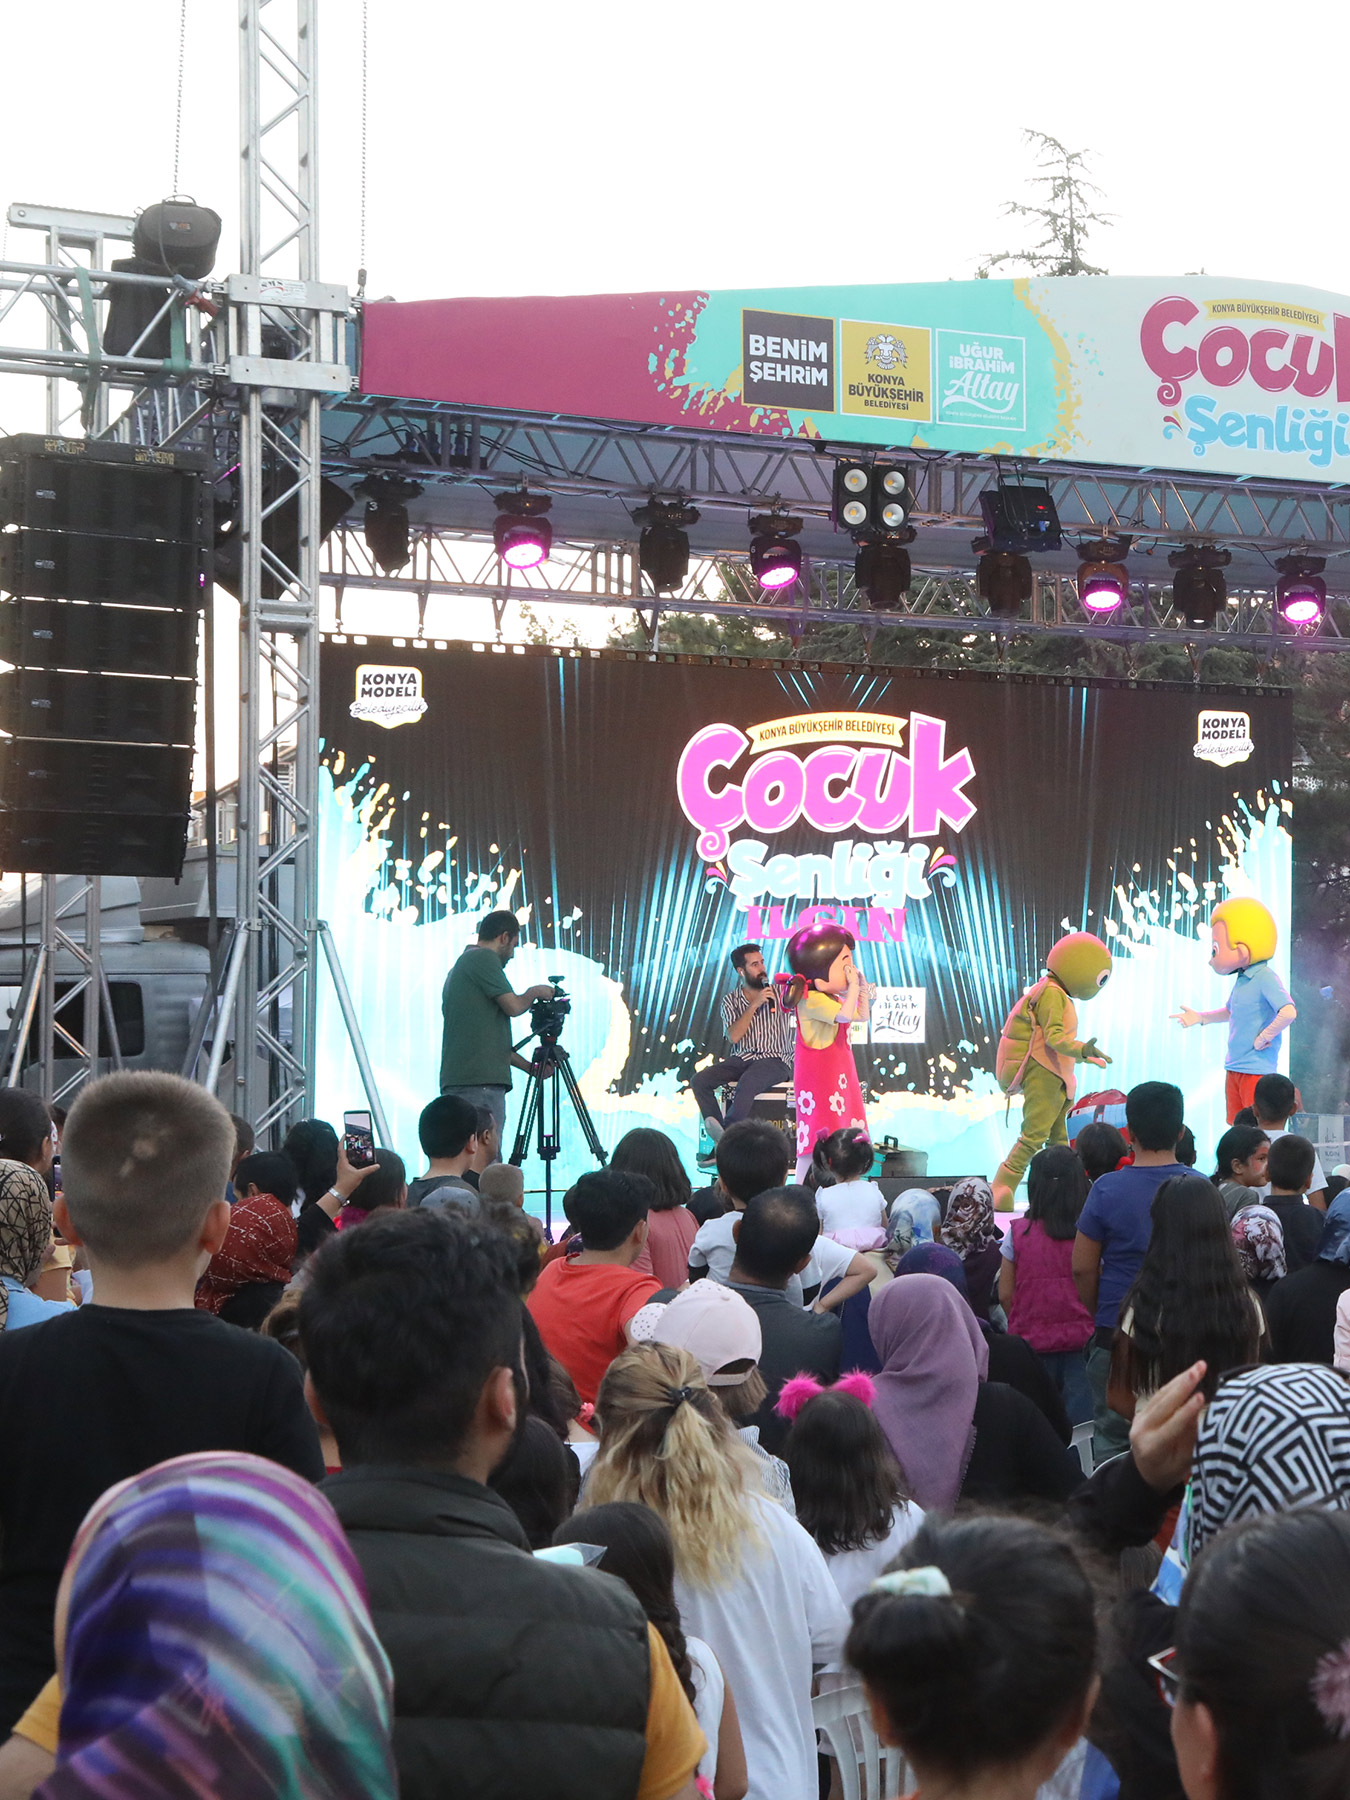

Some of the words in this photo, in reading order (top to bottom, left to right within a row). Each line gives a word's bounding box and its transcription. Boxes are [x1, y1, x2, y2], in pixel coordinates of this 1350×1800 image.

[1212, 304, 1236, 313] KONYA
[1236, 303, 1280, 316] BÜYÜKŞEHİR
[1281, 308, 1320, 325] BELEDİYESİ
[749, 334, 828, 363] BENİM
[959, 341, 1004, 360] UĞUR
[749, 361, 828, 387] ŞEHRİM
[949, 355, 1015, 374] İBRAHİM
[867, 373, 906, 387] KONYA
[848, 384, 925, 404] BÜYÜKŞEHİR
[943, 370, 1020, 414] Altay
[864, 400, 909, 411] BELEDİYESİ
[369, 501, 378, 511] 3
[362, 673, 417, 685] KONYA
[361, 686, 417, 698] MODELİ
[759, 725, 787, 741] KONYA
[788, 718, 843, 735] BÜYÜKŞEHİR
[845, 719, 895, 736] BELEDİYESİ
[1203, 718, 1246, 729] KONYA
[1202, 730, 1246, 740] MODELİ
[677, 711, 977, 862] Çocuk
[727, 839, 932, 913] Şenliği
